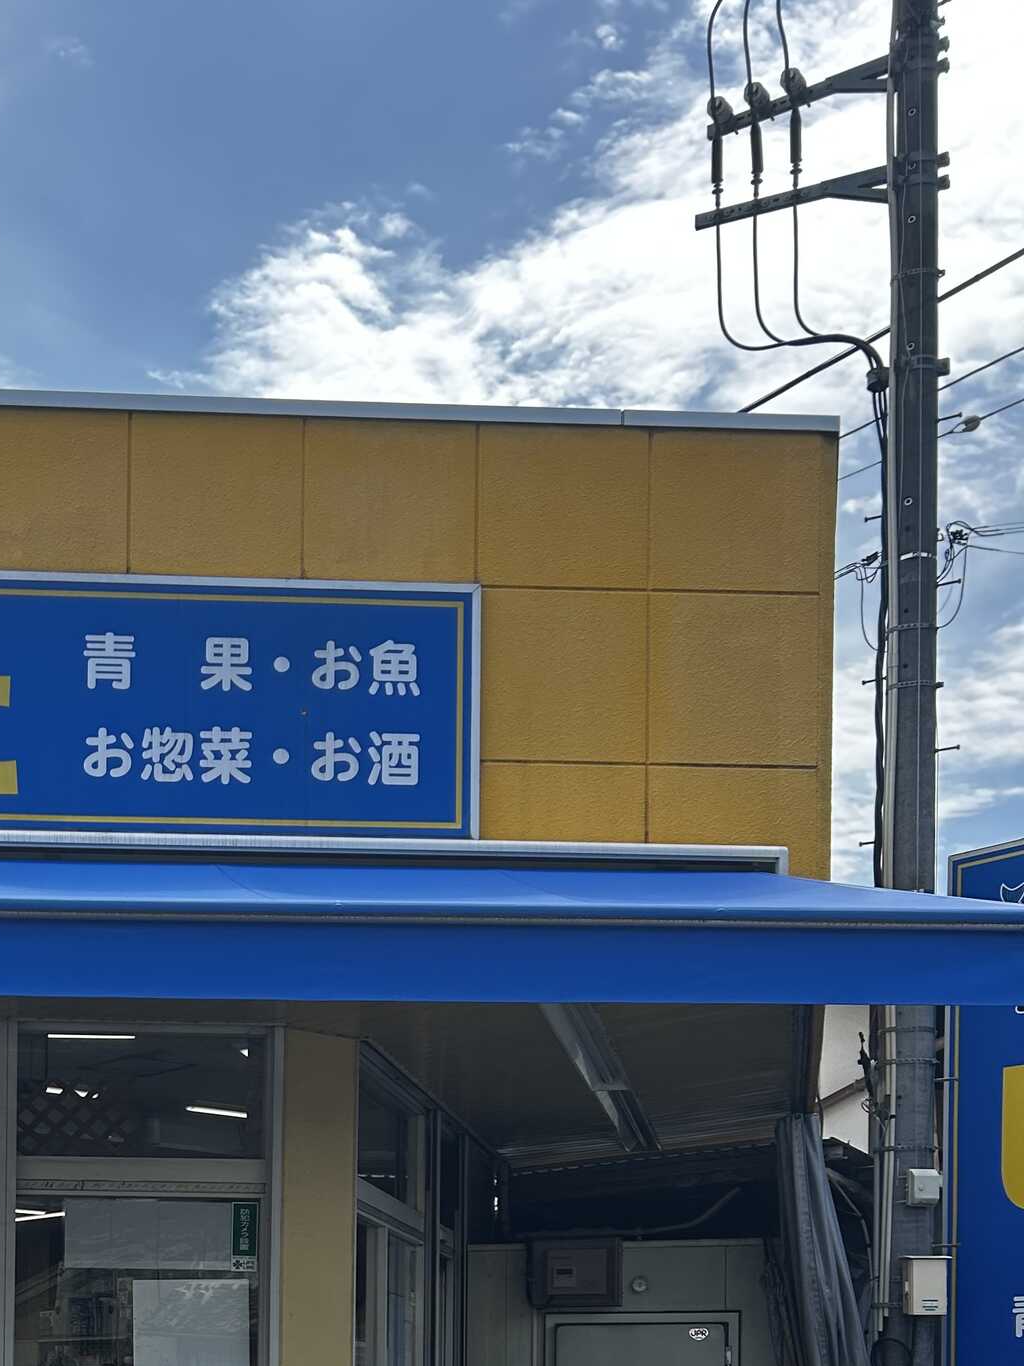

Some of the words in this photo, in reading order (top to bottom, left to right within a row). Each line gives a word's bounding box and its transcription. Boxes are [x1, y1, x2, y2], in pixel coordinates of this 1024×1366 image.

[83, 727, 422, 787] お惣菜・お酒
